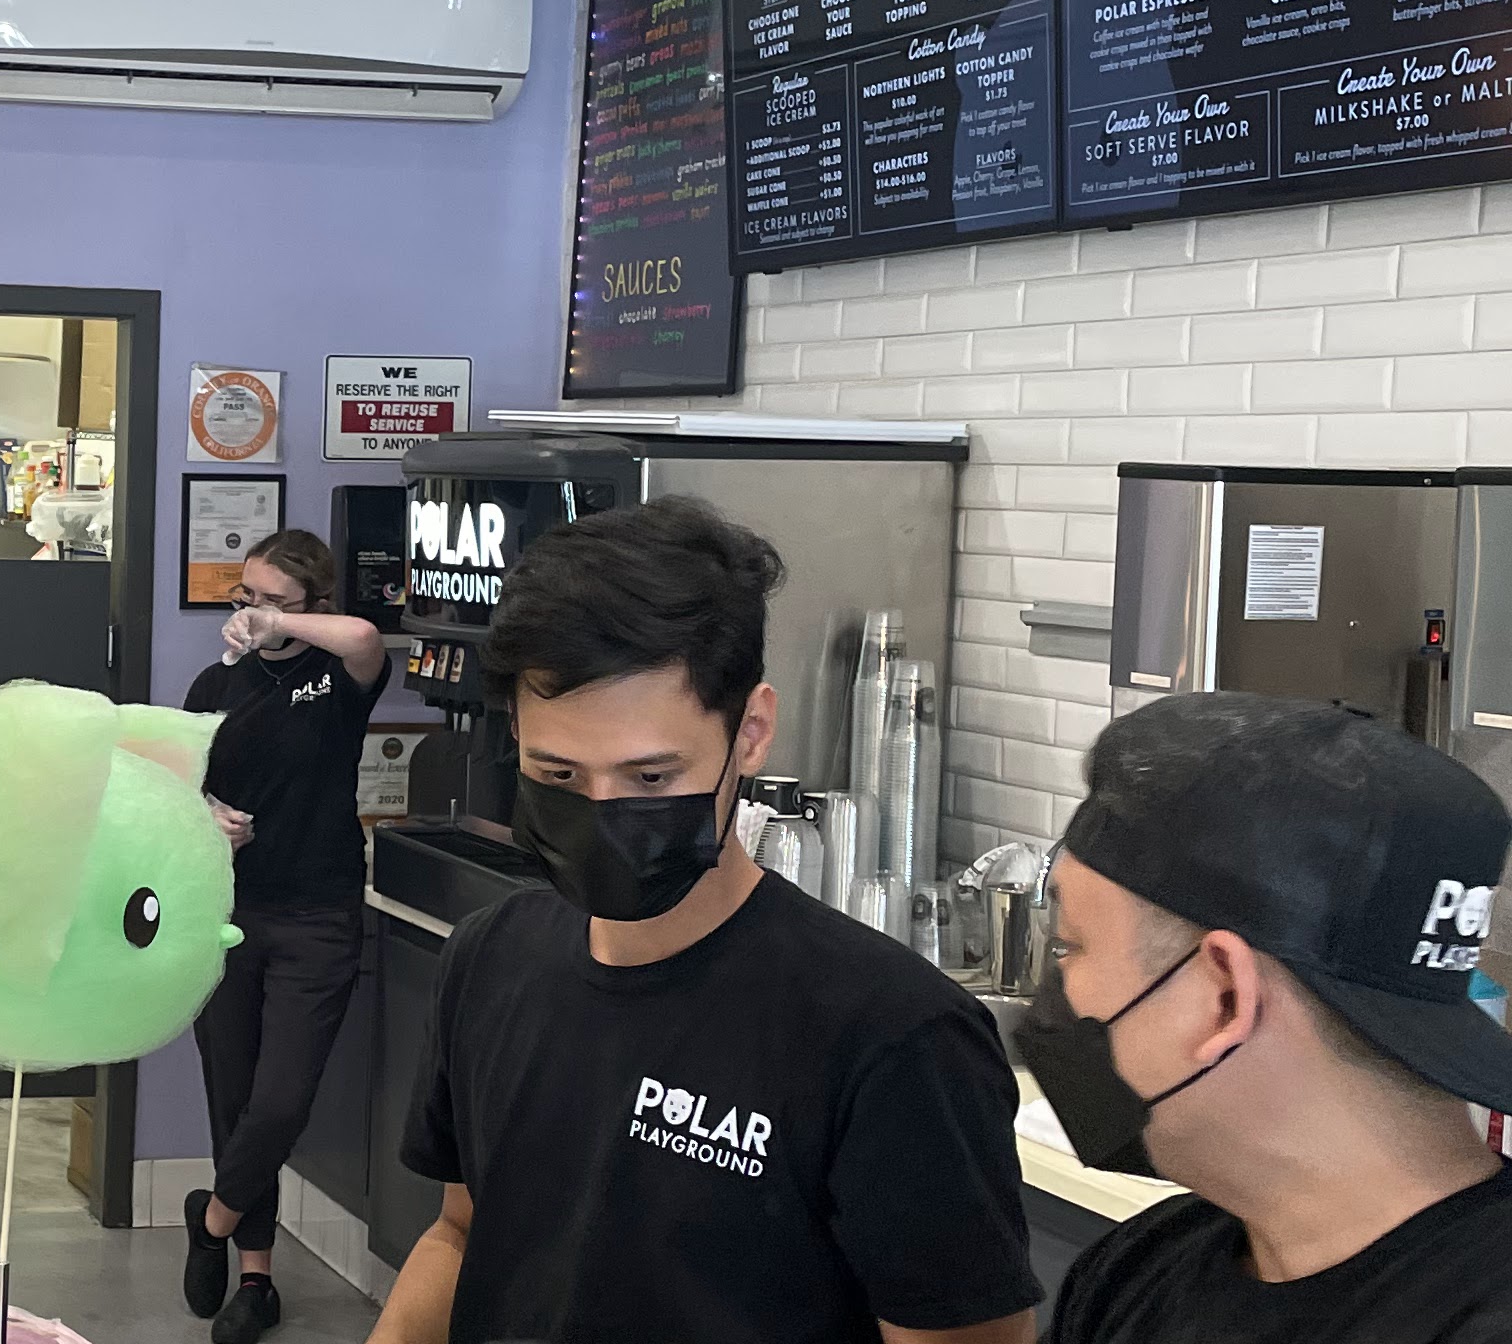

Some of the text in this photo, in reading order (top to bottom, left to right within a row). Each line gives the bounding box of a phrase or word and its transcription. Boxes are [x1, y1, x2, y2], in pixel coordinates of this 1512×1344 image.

[748, 5, 800, 32] CHOOSE ONE
[826, 7, 851, 24] YOUR
[885, 1, 928, 24] TOPPING
[1095, 0, 1137, 24] POLAR
[753, 23, 795, 45] ICE CREAM
[824, 22, 854, 41] SAUCE
[907, 23, 987, 61] Cotton Candy
[759, 40, 790, 59] FLAVOR
[955, 46, 1034, 76] COTTON CANDY
[1337, 47, 1497, 95] Create Your Own
[771, 72, 810, 97] Regular
[862, 66, 946, 99] NORTHERN LIGHTS
[977, 68, 1015, 89] TOPPER
[765, 89, 817, 114] SCOOPED
[891, 94, 917, 110] $10.00
[1314, 76, 1512, 126] MILKSHAKE or MALT
[766, 104, 817, 127] ICE CREAM
[1105, 93, 1231, 135] Create Your Own
[1396, 113, 1430, 131] $7.00
[751, 136, 773, 149] SCOOP
[788, 143, 811, 158] SCOOP
[1085, 120, 1250, 162] SOFT SERVE FLAVOR
[872, 151, 929, 174] CHARACTERS
[975, 148, 1017, 166] FLAVORS
[1151, 152, 1178, 167] $7.00
[763, 166, 781, 179] CONE
[746, 183, 768, 197] SUGAR
[768, 181, 787, 194] CONE
[770, 196, 789, 209] CONE
[743, 220, 761, 235] ICE
[763, 213, 798, 232] CREAM
[800, 205, 848, 225] FLAVORS
[601, 256, 682, 303] SAUCES
[380, 366, 418, 380] WE
[335, 383, 461, 399] RESERVE THE RIGHT
[223, 402, 245, 411] PASS
[355, 403, 439, 417] TO REFUSE
[369, 418, 425, 432] SERVICE
[361, 437, 433, 450] TO ANYON
[409, 499, 507, 569] POLAR
[410, 569, 504, 606] PLAYGROUND
[377, 794, 405, 805] 2020
[633, 1076, 773, 1157] POLAR
[629, 1119, 764, 1178] PLAYGROUND
